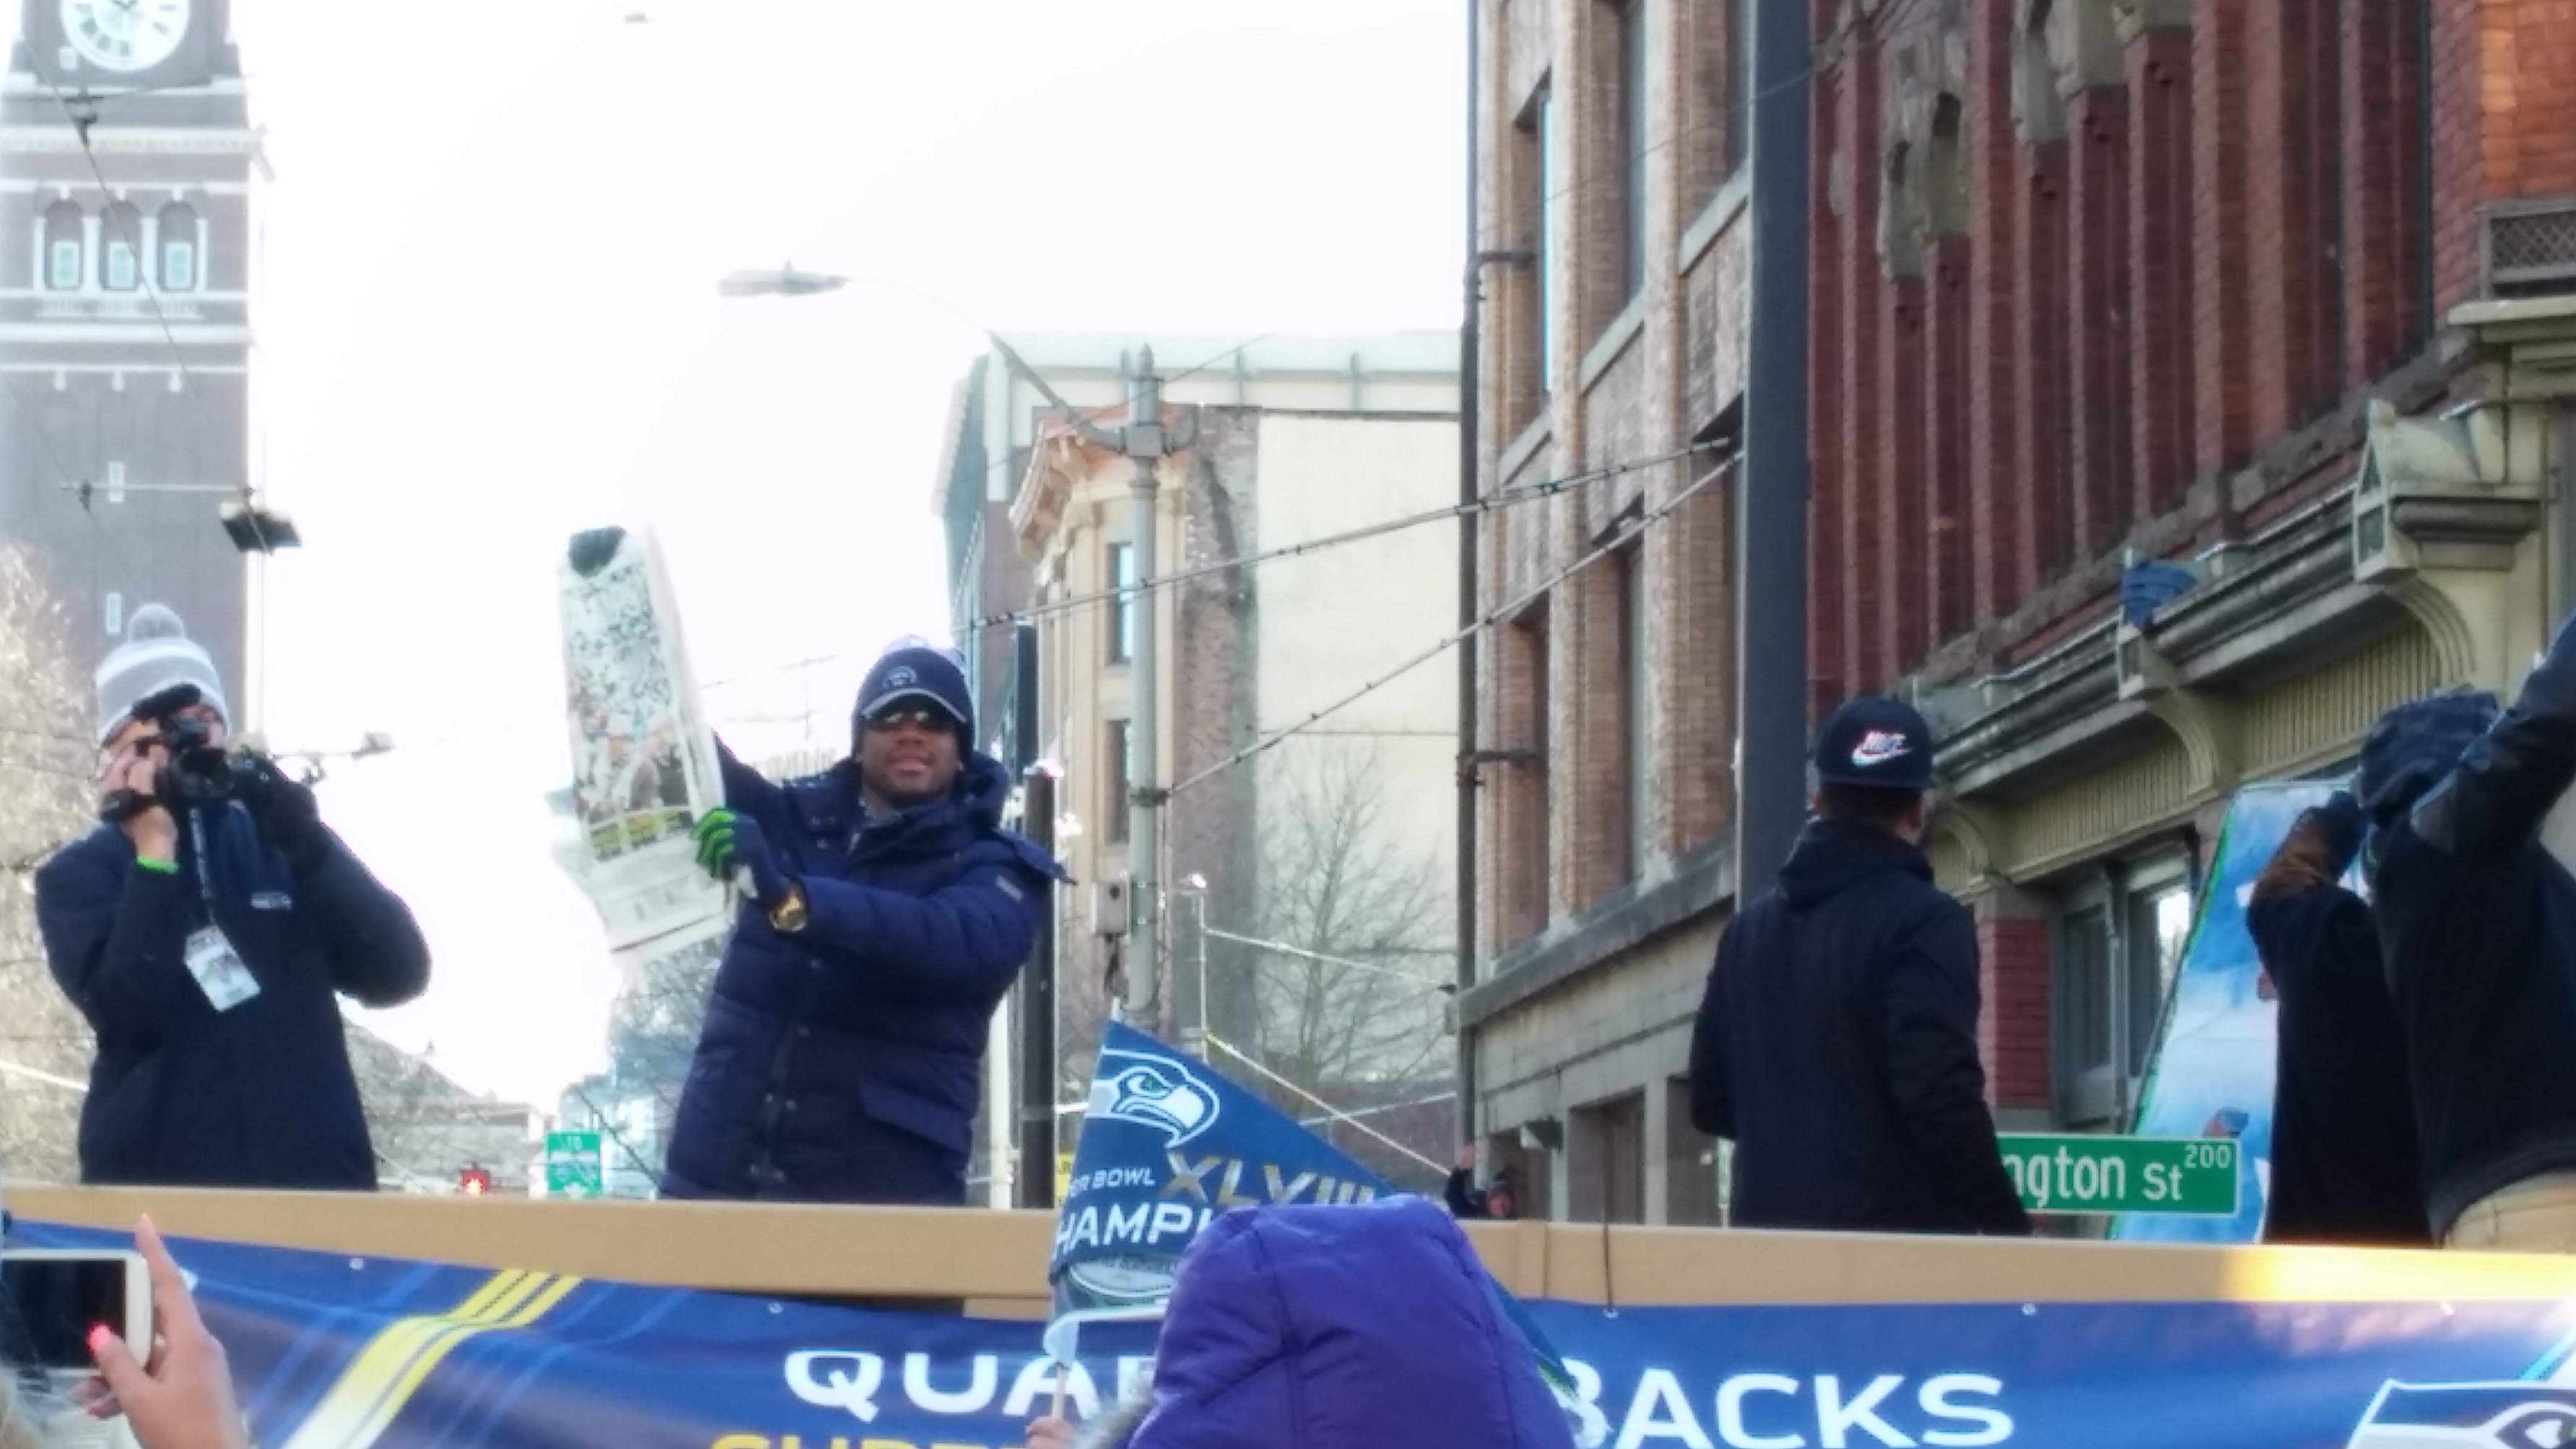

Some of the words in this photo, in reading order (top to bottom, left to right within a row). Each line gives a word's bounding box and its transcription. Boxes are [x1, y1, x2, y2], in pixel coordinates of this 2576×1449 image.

[2183, 1143, 2231, 1169] 200
[1091, 1167, 1156, 1189] BOWL
[1158, 1151, 1376, 1206] XLVIII
[2142, 1160, 2183, 1201] St
